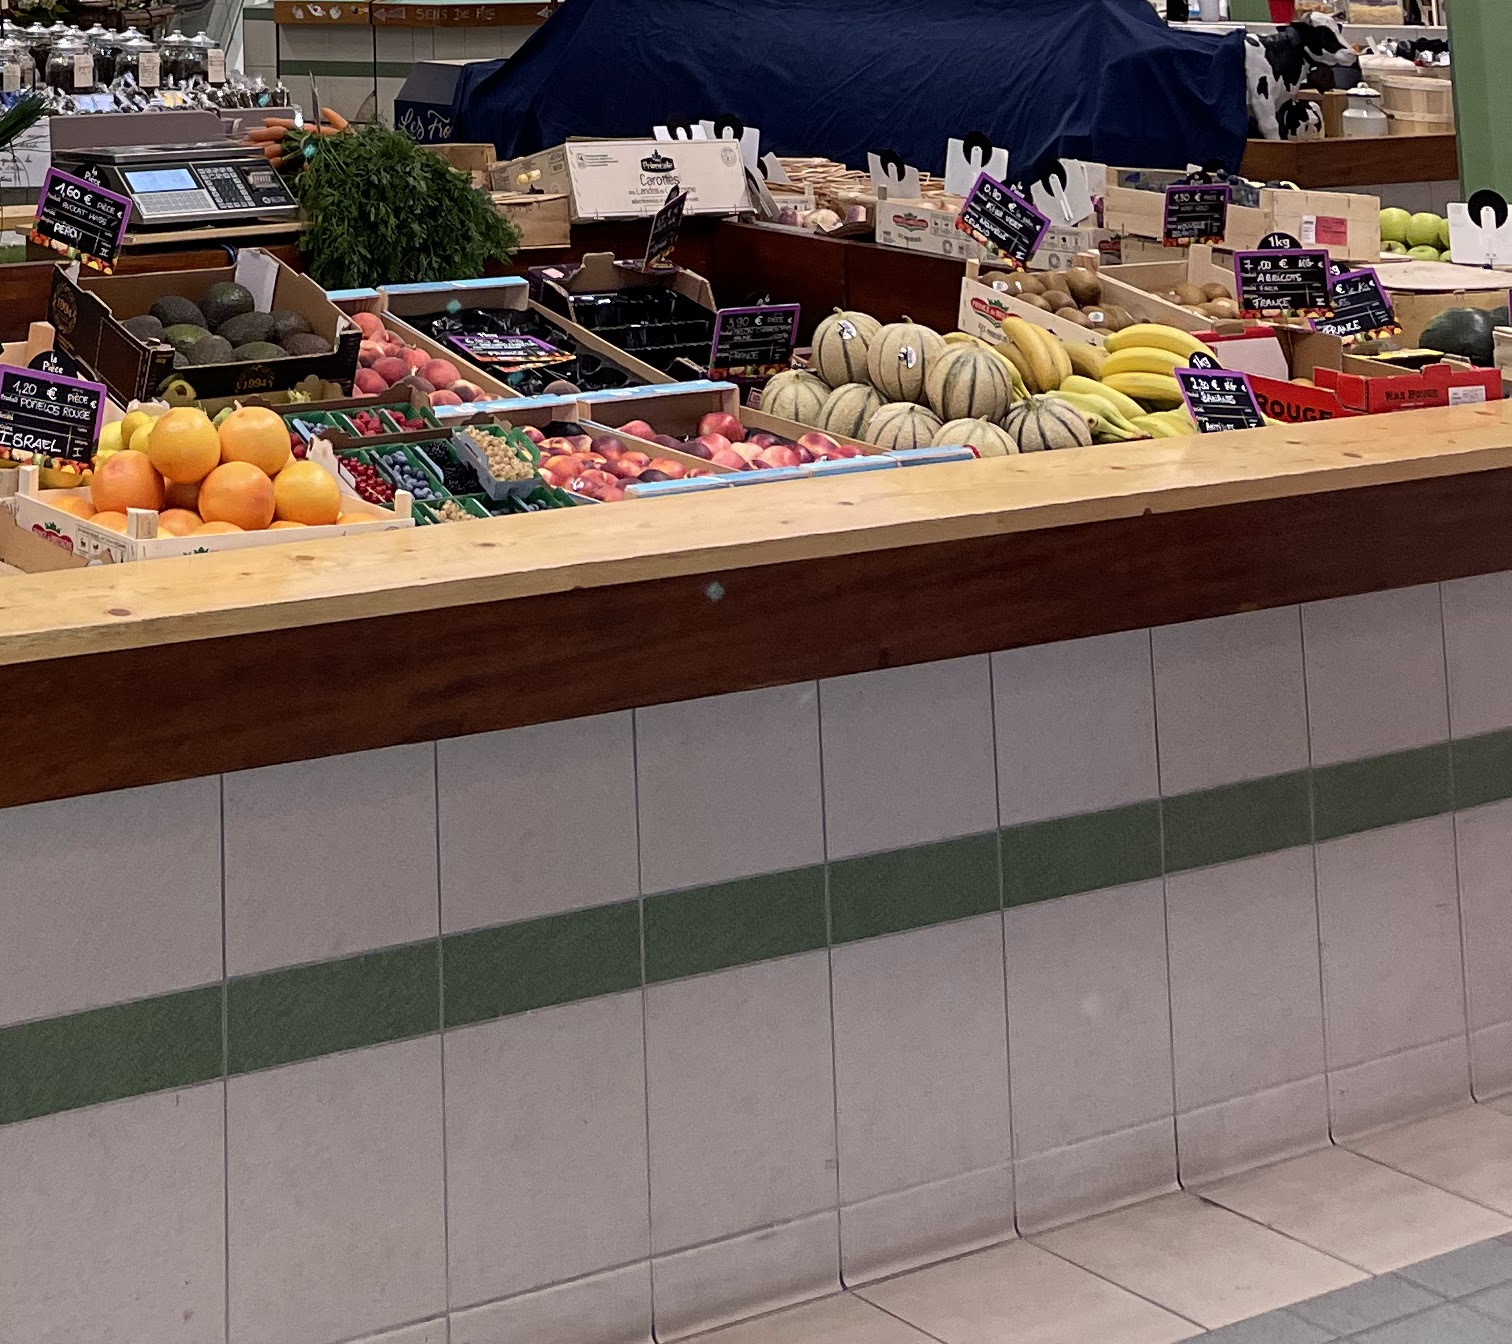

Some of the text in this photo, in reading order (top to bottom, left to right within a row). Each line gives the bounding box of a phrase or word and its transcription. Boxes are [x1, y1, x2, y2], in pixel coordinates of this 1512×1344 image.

[639, 173, 680, 186] Carottes
[54, 183, 81, 200] 1,60
[84, 194, 93, 206] €
[62, 201, 86, 216] AVOCAT
[1268, 235, 1290, 249] 1kg
[1279, 259, 1288, 269] €
[1257, 273, 1302, 283] ABRICOTS
[1252, 297, 1291, 310] FRANCE
[12, 380, 37, 396] 1,20
[46, 386, 57, 401] €
[20, 397, 60, 416] POMELOS
[62, 406, 91, 421] ROUGE
